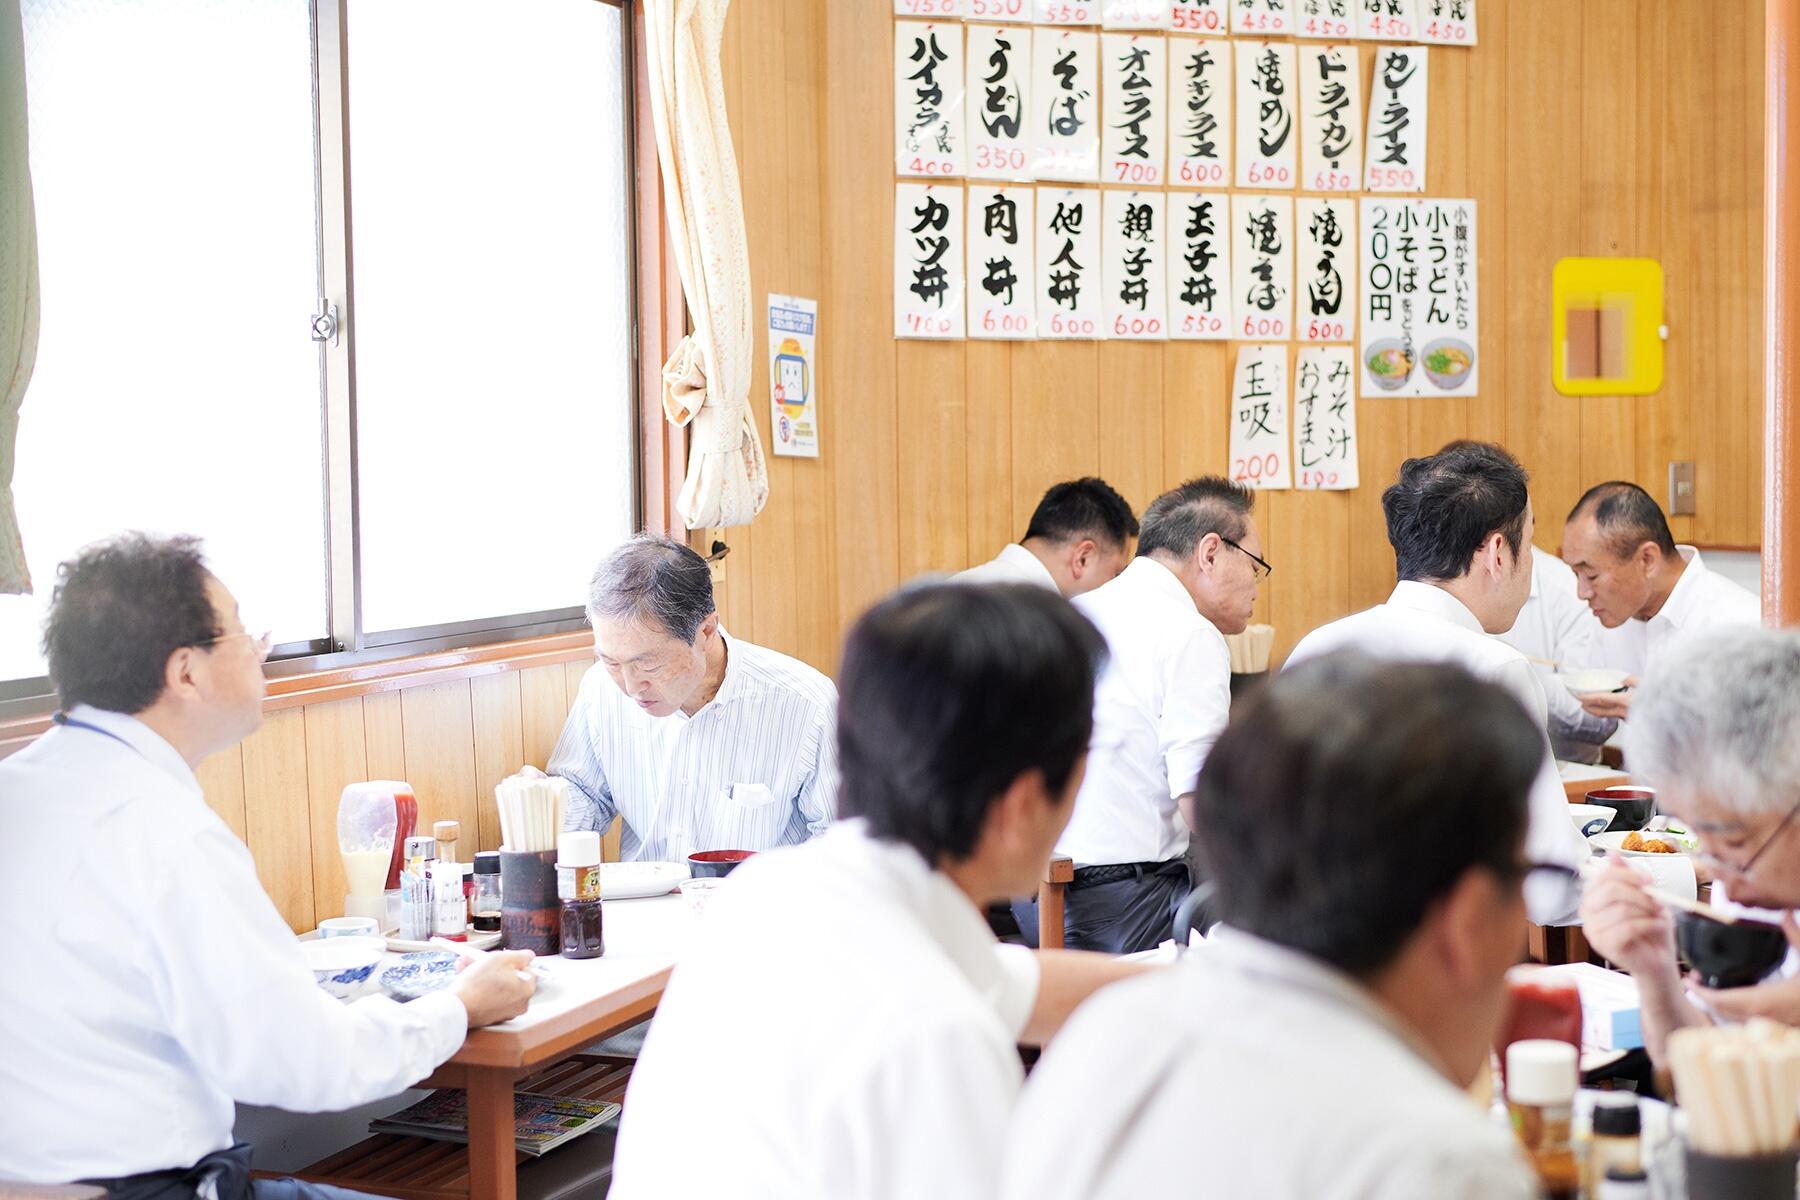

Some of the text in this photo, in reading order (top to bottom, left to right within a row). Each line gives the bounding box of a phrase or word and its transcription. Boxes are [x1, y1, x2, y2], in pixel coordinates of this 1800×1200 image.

[1044, 5, 1087, 22] 550
[1173, 6, 1219, 30] 550
[1242, 13, 1283, 30] 450
[1371, 15, 1410, 35] 450
[1306, 18, 1348, 36] 450
[1427, 20, 1465, 40] 450
[907, 32, 949, 127] ハイカラ
[980, 38, 1022, 139] うどん
[1049, 47, 1090, 137] そば
[1110, 46, 1152, 159] オムライス
[1177, 50, 1218, 158] チキンライス
[1314, 51, 1353, 169] ドライカレー
[1374, 51, 1417, 166] カレーライス
[909, 157, 953, 174] 400
[976, 144, 1025, 170] 350
[1114, 162, 1157, 182] 700
[1181, 160, 1223, 182] 600
[1248, 162, 1289, 184] 600
[1315, 171, 1351, 190] 650
[1369, 165, 1416, 189] 550
[907, 195, 949, 309] カツ丼
[982, 194, 1018, 306] 肉丼
[1048, 202, 1085, 311] 他人丼
[1118, 203, 1154, 311] 親子丼
[1180, 201, 1218, 312] 玉子丼
[1246, 208, 1286, 311] 焼そば
[1426, 205, 1449, 324] 小うどん
[983, 309, 1028, 331] 600
[1051, 313, 1095, 334] 600
[1115, 313, 1160, 335] 600
[1182, 315, 1222, 333] 550
[1244, 315, 1284, 336] 600
[1308, 320, 1344, 339] 600
[1239, 361, 1279, 440] 玉吸
[1326, 360, 1351, 460] みそ汁
[1299, 360, 1322, 468] おすまし
[1235, 450, 1280, 481] 200
[1302, 471, 1339, 486] 100
